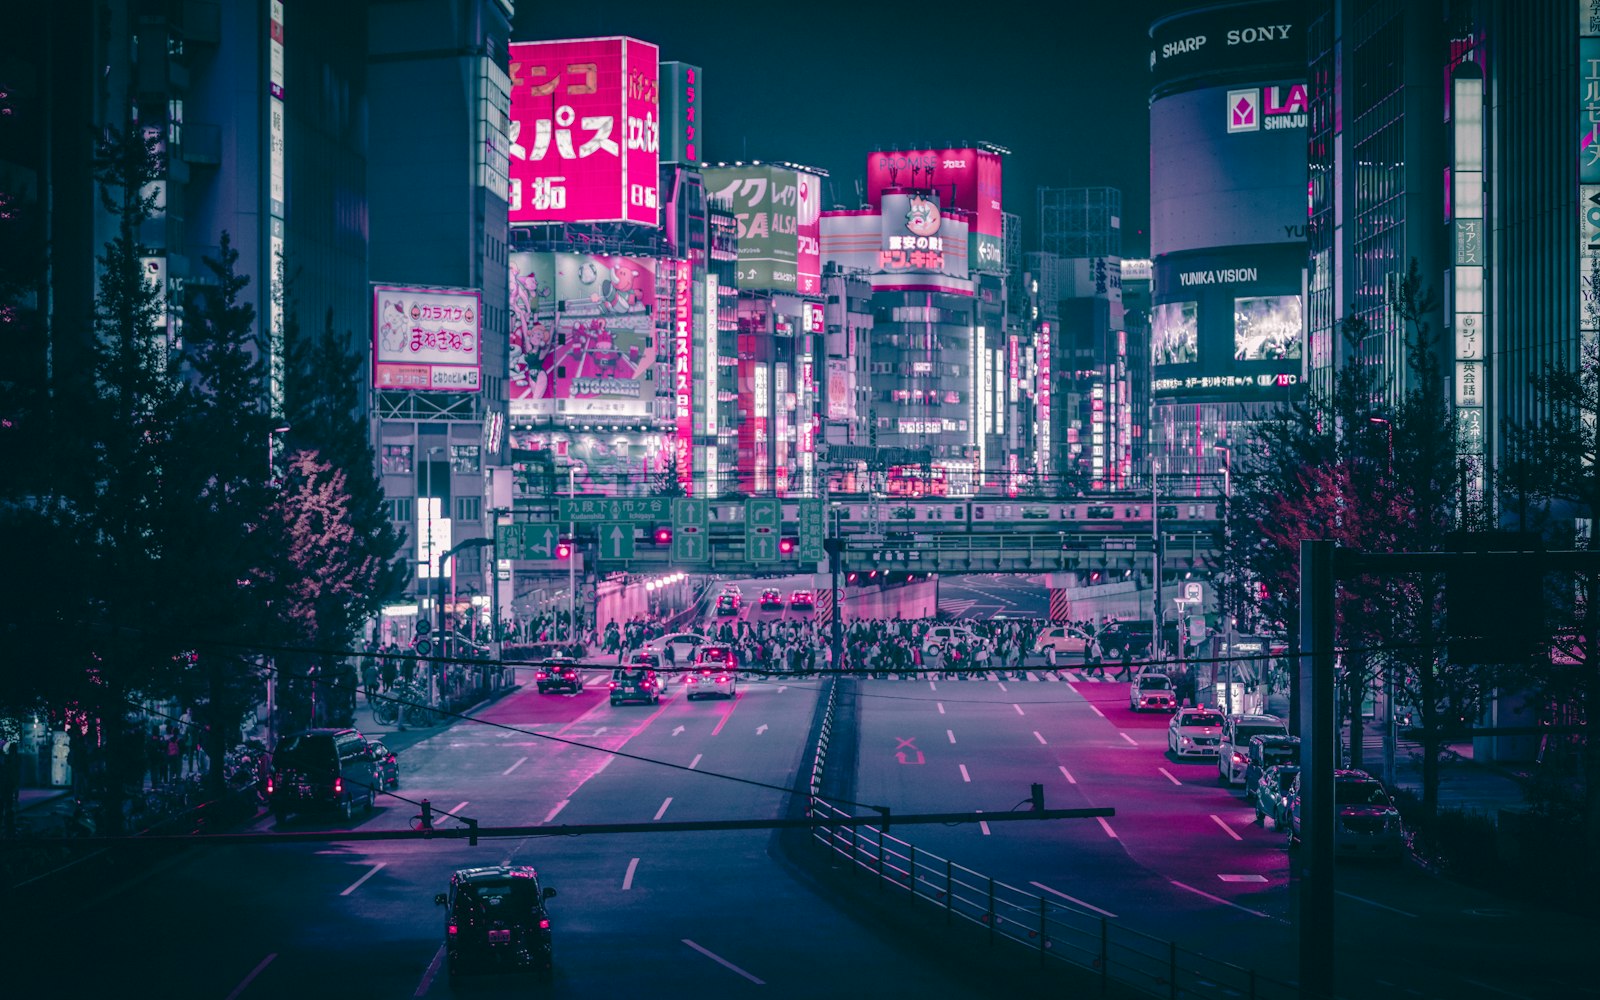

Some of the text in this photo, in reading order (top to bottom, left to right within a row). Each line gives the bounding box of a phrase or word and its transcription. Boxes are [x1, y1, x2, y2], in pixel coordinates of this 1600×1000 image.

[1227, 24, 1292, 45] SONY
[1162, 35, 1207, 58] SHARP
[628, 111, 659, 153] エスパス
[879, 157, 937, 171] PROMISE
[943, 160, 967, 169] プロミス
[771, 182, 796, 207] レイク
[771, 213, 797, 235] ALSA
[798, 235, 820, 256] アコム
[889, 236, 943, 250] 驚安の殿
[1465, 222, 1476, 263] オアシス
[1180, 268, 1258, 286] YUNIKA VISION
[678, 267, 688, 318] パチンコ
[422, 306, 463, 320] カラオケ
[410, 328, 474, 352] まねきねこ
[677, 321, 688, 390] エスパス
[568, 500, 609, 512] 九段下
